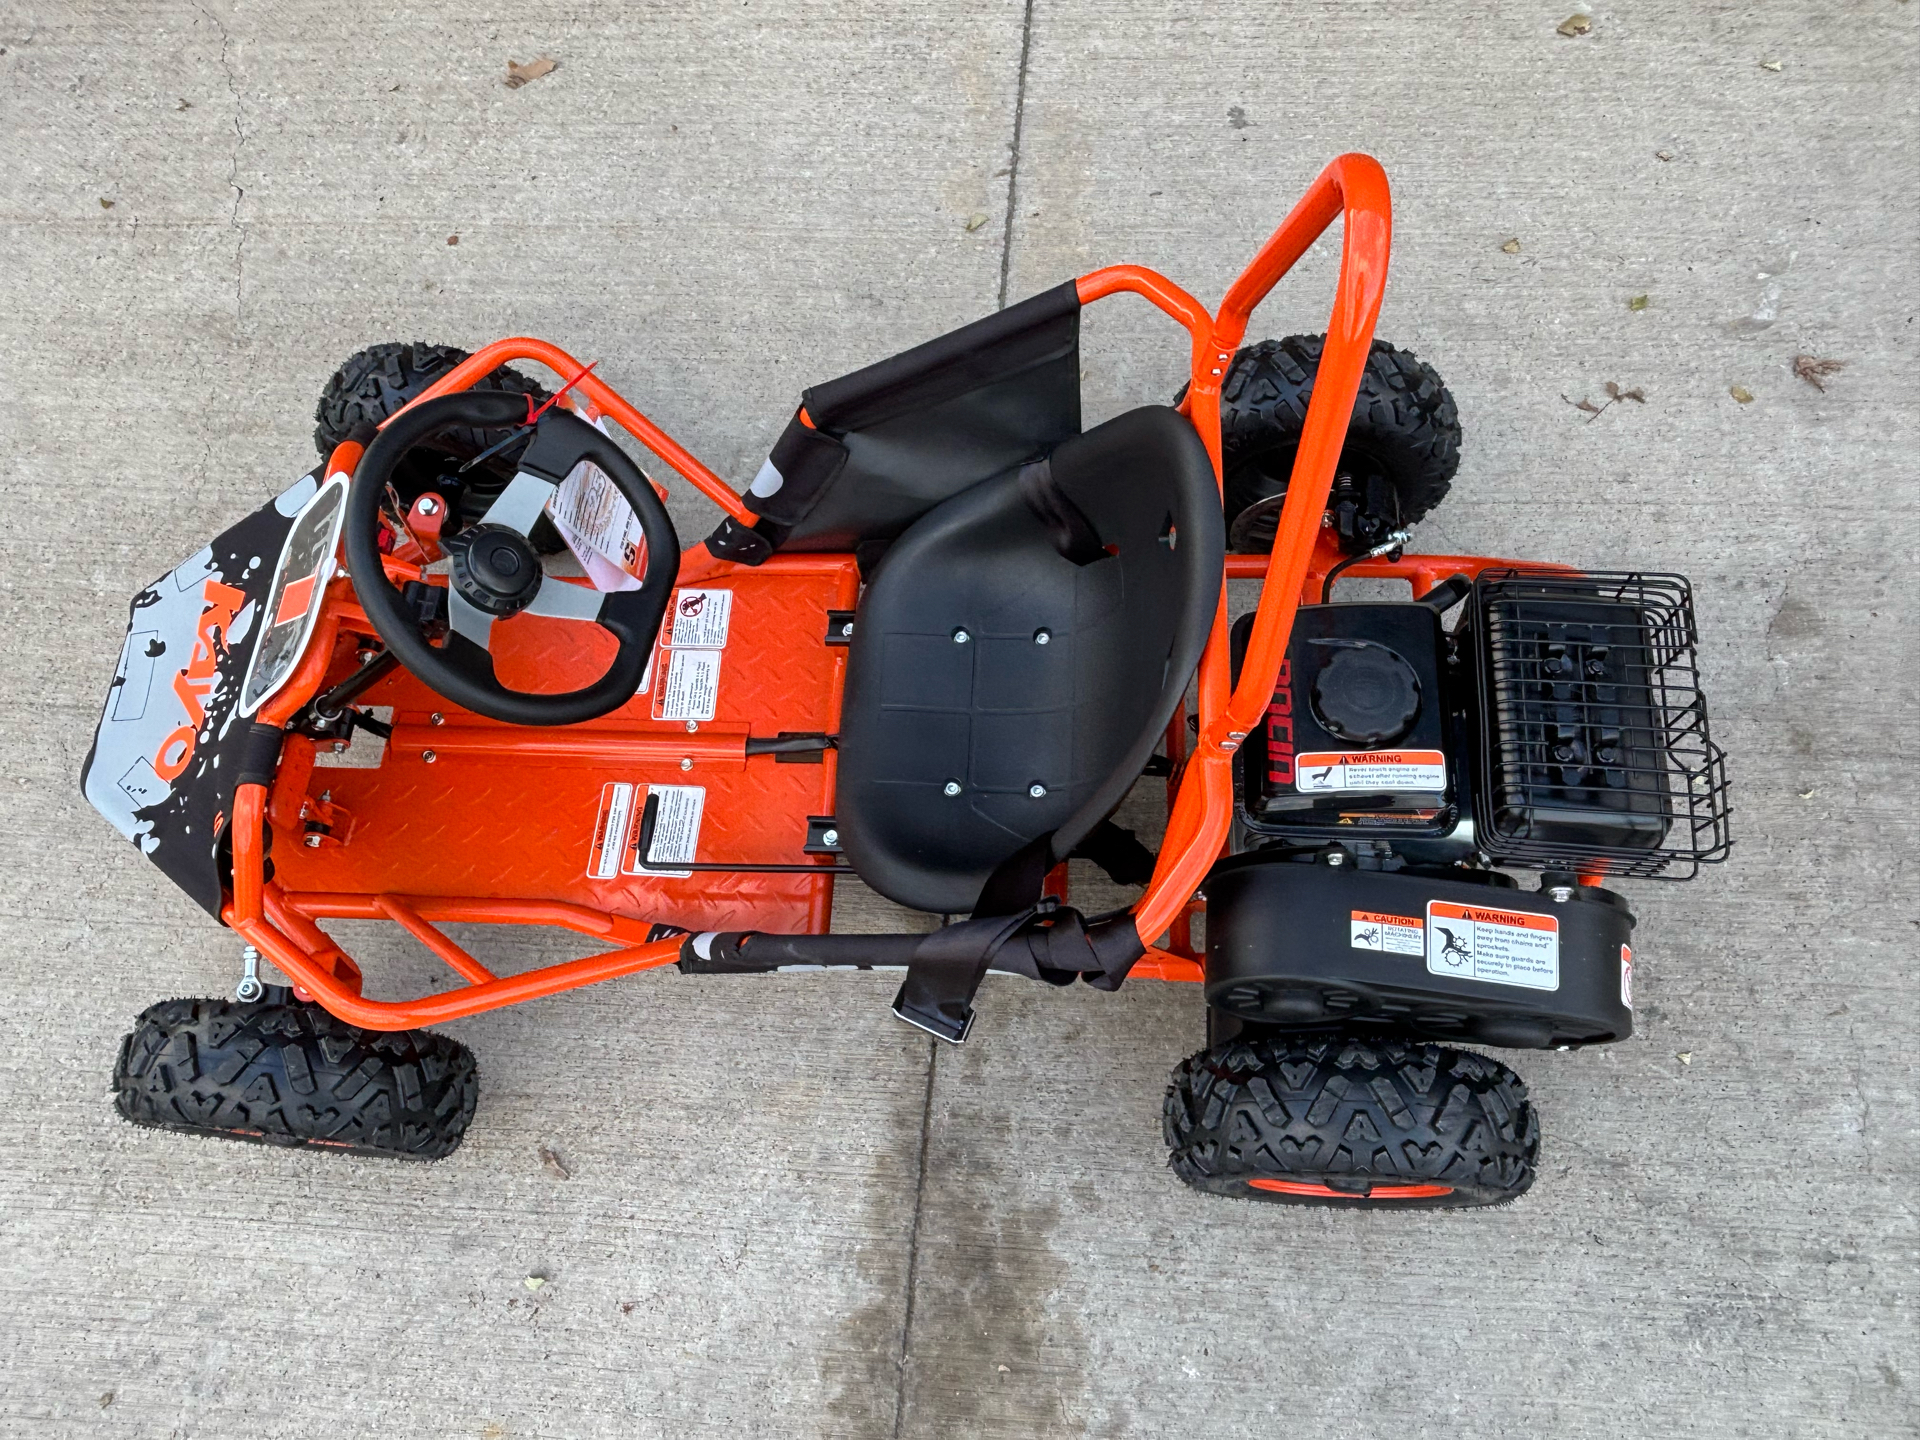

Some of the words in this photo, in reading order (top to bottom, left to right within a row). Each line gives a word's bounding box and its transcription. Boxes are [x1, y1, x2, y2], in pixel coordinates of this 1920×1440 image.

[154, 579, 246, 781] KAYO
[1352, 754, 1402, 764] WARNING
[1375, 772, 1391, 780] after
[631, 806, 643, 841] WARNING
[1374, 914, 1414, 926] CAUTION
[1475, 911, 1525, 926] WARNING
[1476, 926, 1494, 934] Keep
[1494, 928, 1515, 937] hands
[1530, 932, 1553, 942] fingers
[1476, 935, 1494, 943] away
[1494, 936, 1510, 944] from
[1511, 938, 1534, 947] chains
[1476, 944, 1510, 952] sprockets.
[1476, 950, 1494, 958] Make
[1511, 955, 1534, 964] guards
[1476, 960, 1504, 968] securely
[1513, 963, 1531, 972] place
[1532, 966, 1554, 974] before
[1476, 968, 1510, 977] operation.
